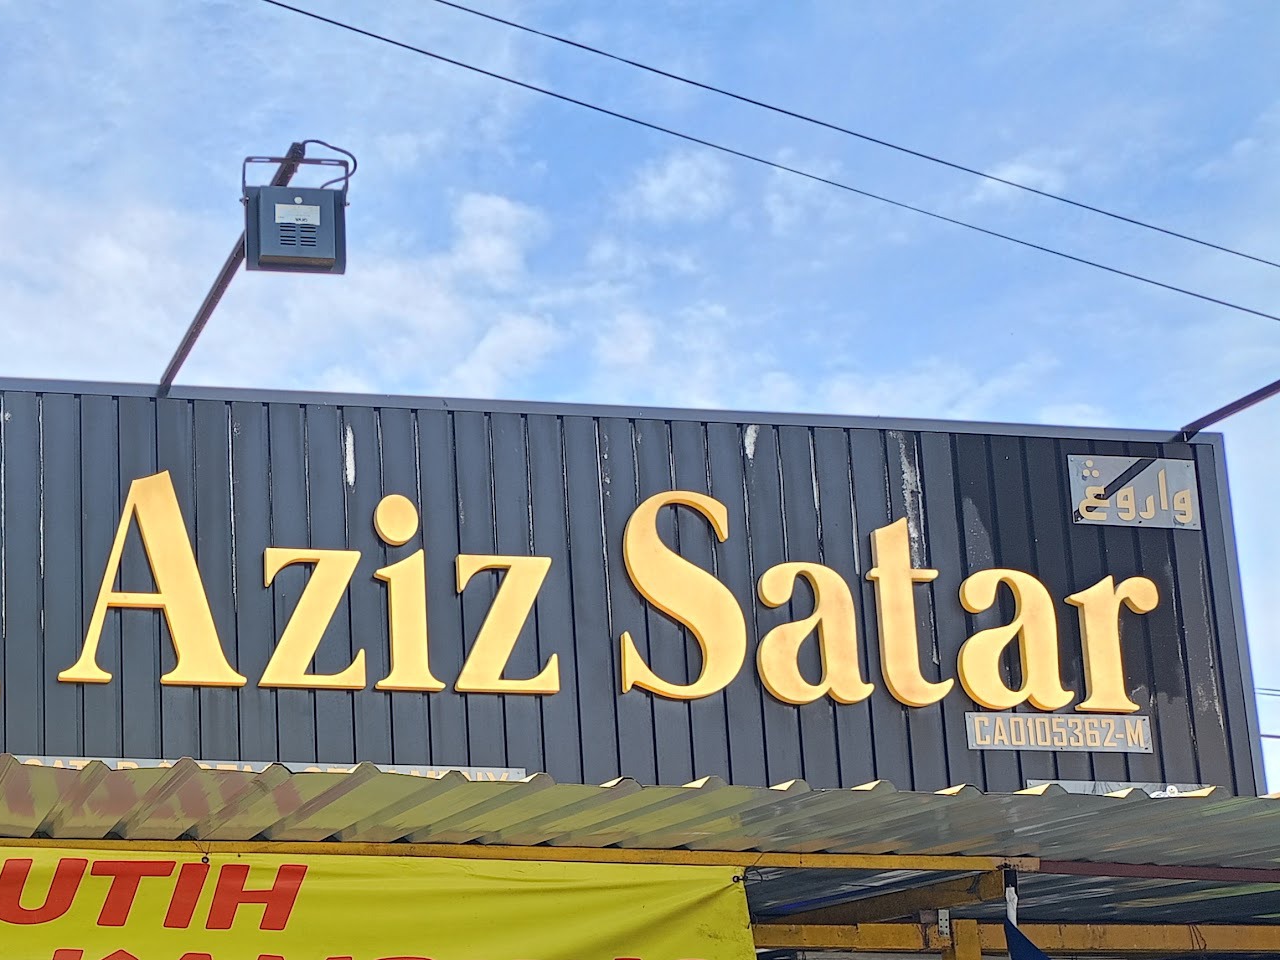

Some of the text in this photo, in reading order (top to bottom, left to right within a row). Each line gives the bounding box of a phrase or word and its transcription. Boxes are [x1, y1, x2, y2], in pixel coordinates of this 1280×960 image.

[57, 470, 562, 695] Aziz
[619, 490, 1160, 714] Satar
[974, 716, 1146, 748] CA0105362-M
